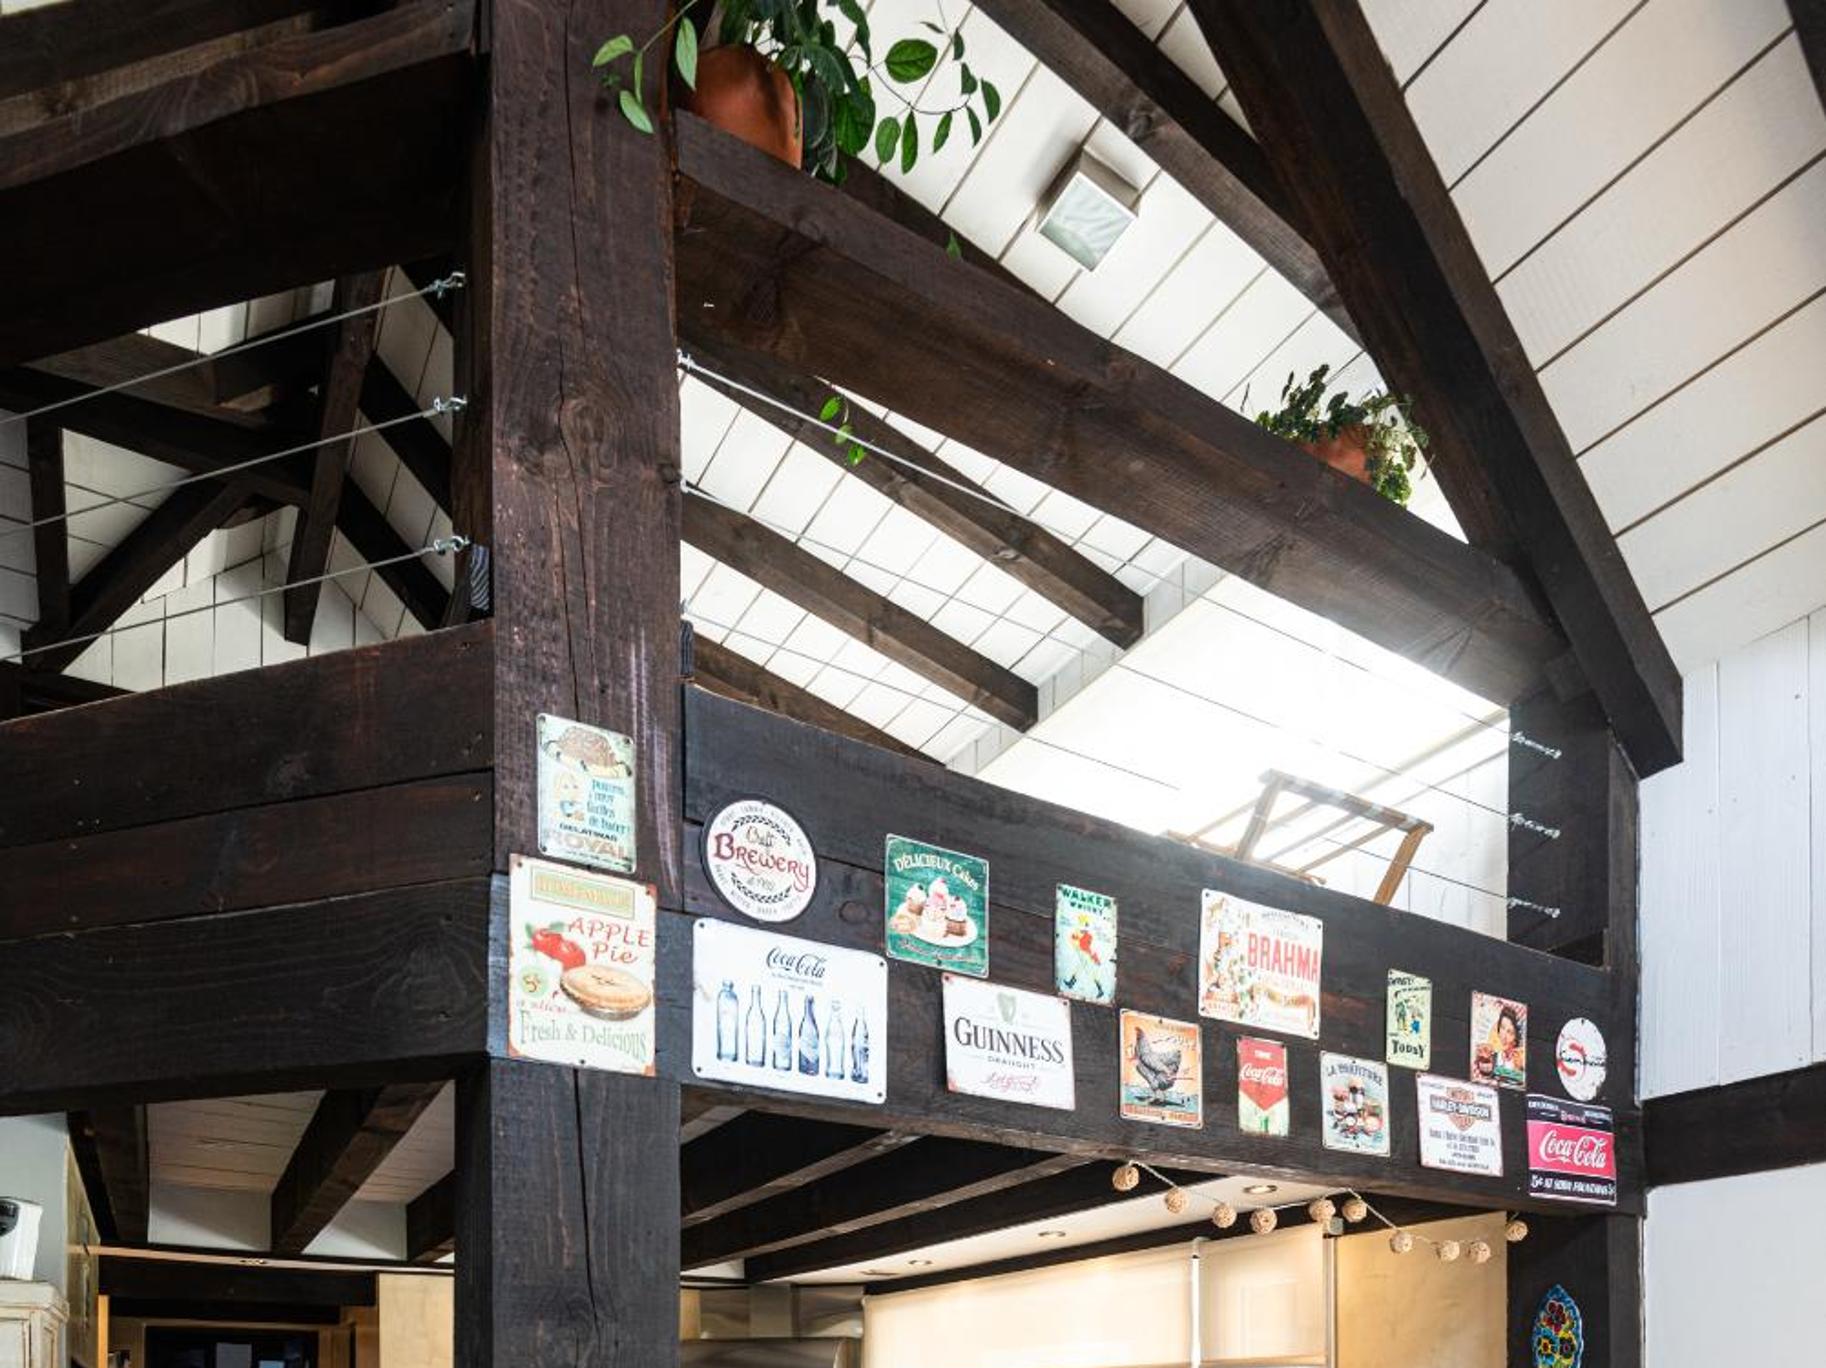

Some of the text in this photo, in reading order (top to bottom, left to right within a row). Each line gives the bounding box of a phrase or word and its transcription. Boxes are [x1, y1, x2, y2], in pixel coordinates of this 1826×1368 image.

[568, 916, 650, 948] APPLE
[592, 942, 639, 965] Pie
[1247, 932, 1320, 984] BRAHMA
[520, 1010, 648, 1063] Fresh & Delicious
[953, 1016, 1065, 1065] GUINNESS
[987, 1055, 1037, 1070] DRAUGHT
